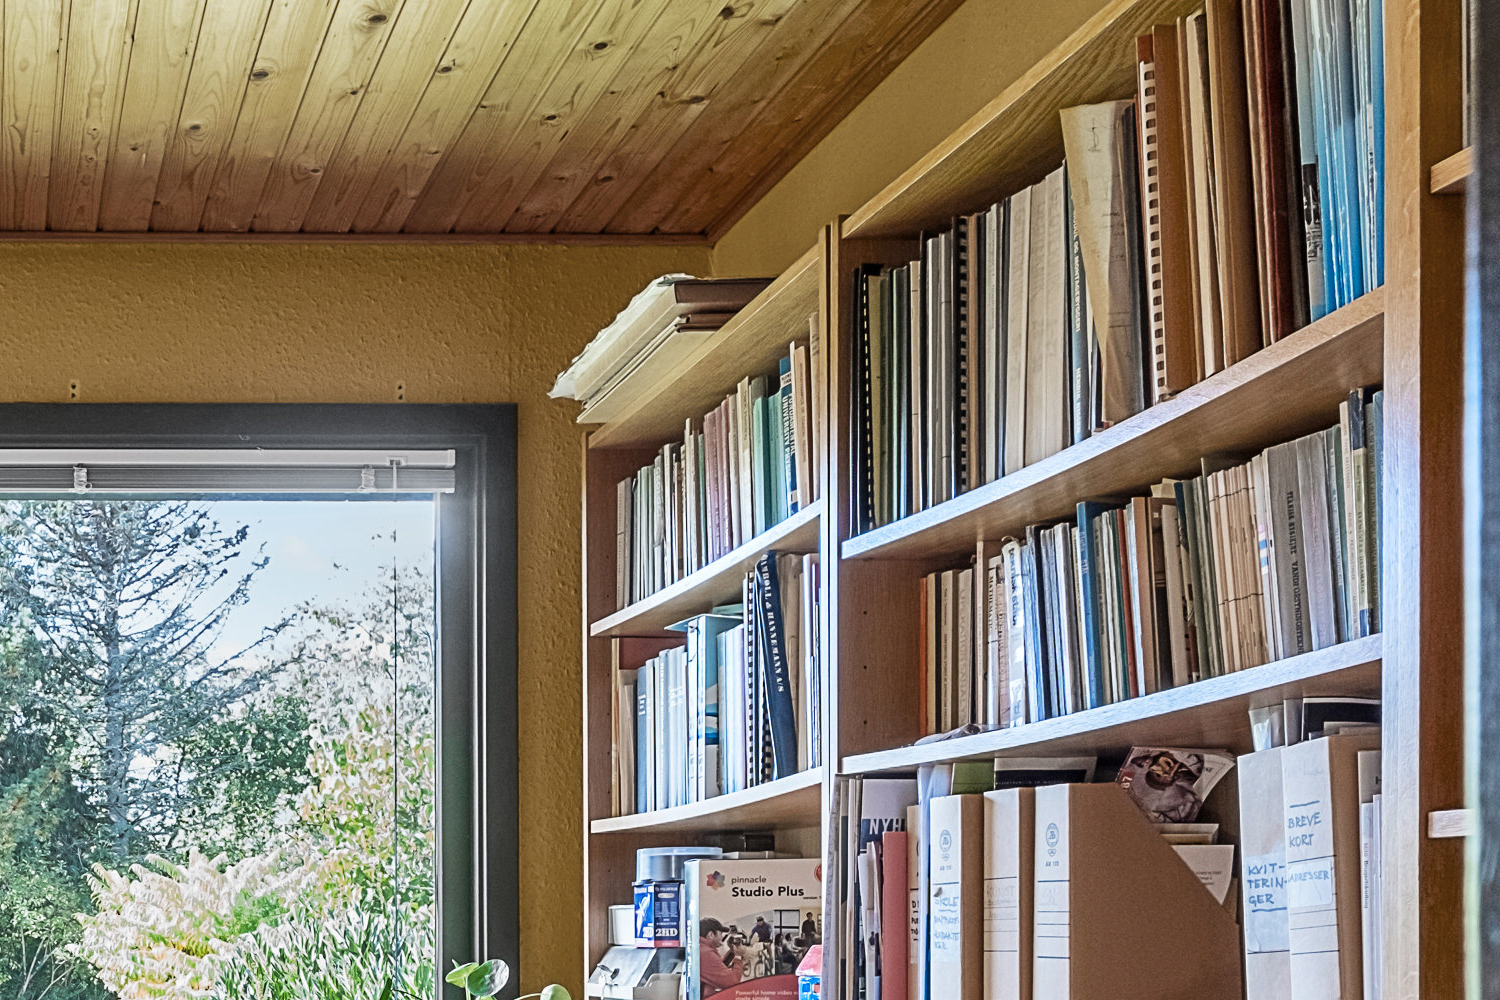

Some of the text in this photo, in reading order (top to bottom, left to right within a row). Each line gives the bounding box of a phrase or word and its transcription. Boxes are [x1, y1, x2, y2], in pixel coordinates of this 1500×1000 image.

[782, 396, 790, 445] UNIVERSITY
[767, 612, 781, 674] HANNEMANN
[776, 676, 784, 693] A/S
[1288, 812, 1322, 829] BREVE
[1289, 833, 1314, 848] KORT
[731, 876, 767, 885] pinnacle
[1288, 870, 1330, 882] ADRESSER
[732, 886, 773, 897] Studio
[778, 886, 804, 897] Plus
[1249, 893, 1275, 907] GER
[655, 928, 678, 937] 2HD
